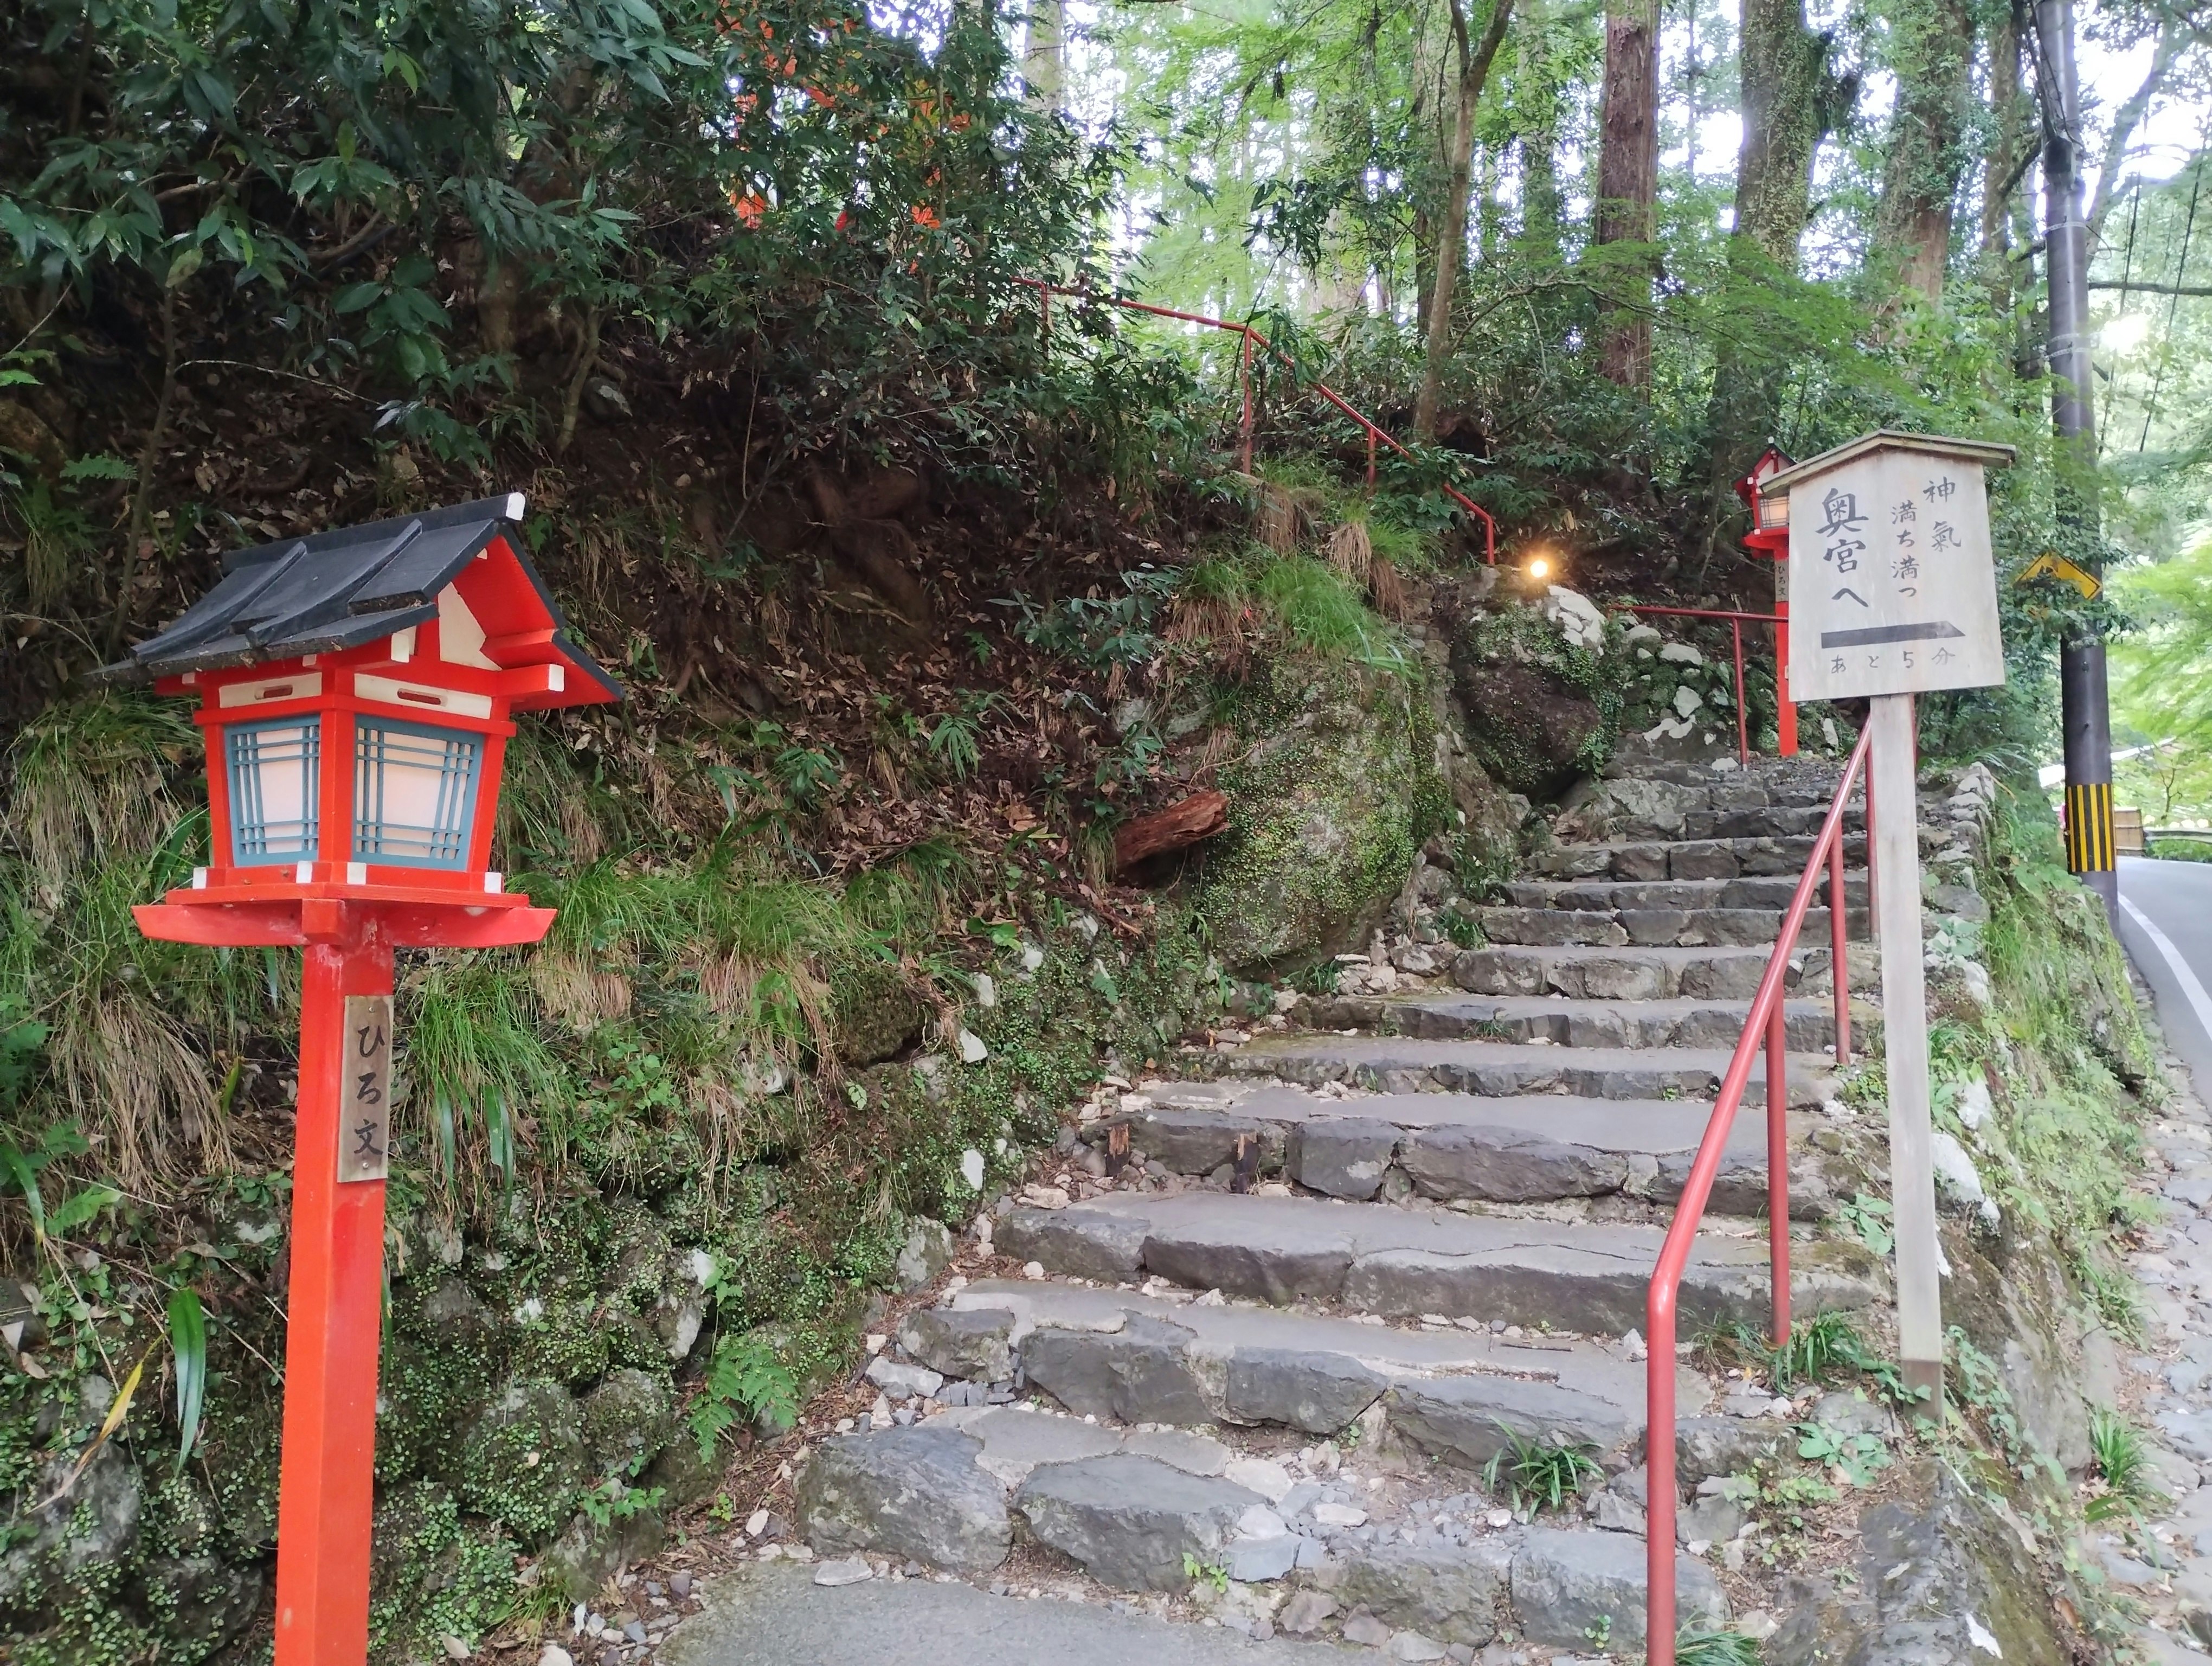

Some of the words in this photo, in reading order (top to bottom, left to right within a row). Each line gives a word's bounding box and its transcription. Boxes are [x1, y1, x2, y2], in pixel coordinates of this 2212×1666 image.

[1815, 488, 1869, 608] 奥宮へ
[1891, 499, 1920, 598] 満ち満つ
[1923, 476, 1962, 552] 神氣
[1777, 565, 1786, 597] ひろ文
[354, 1026, 385, 1155] ひろ文
